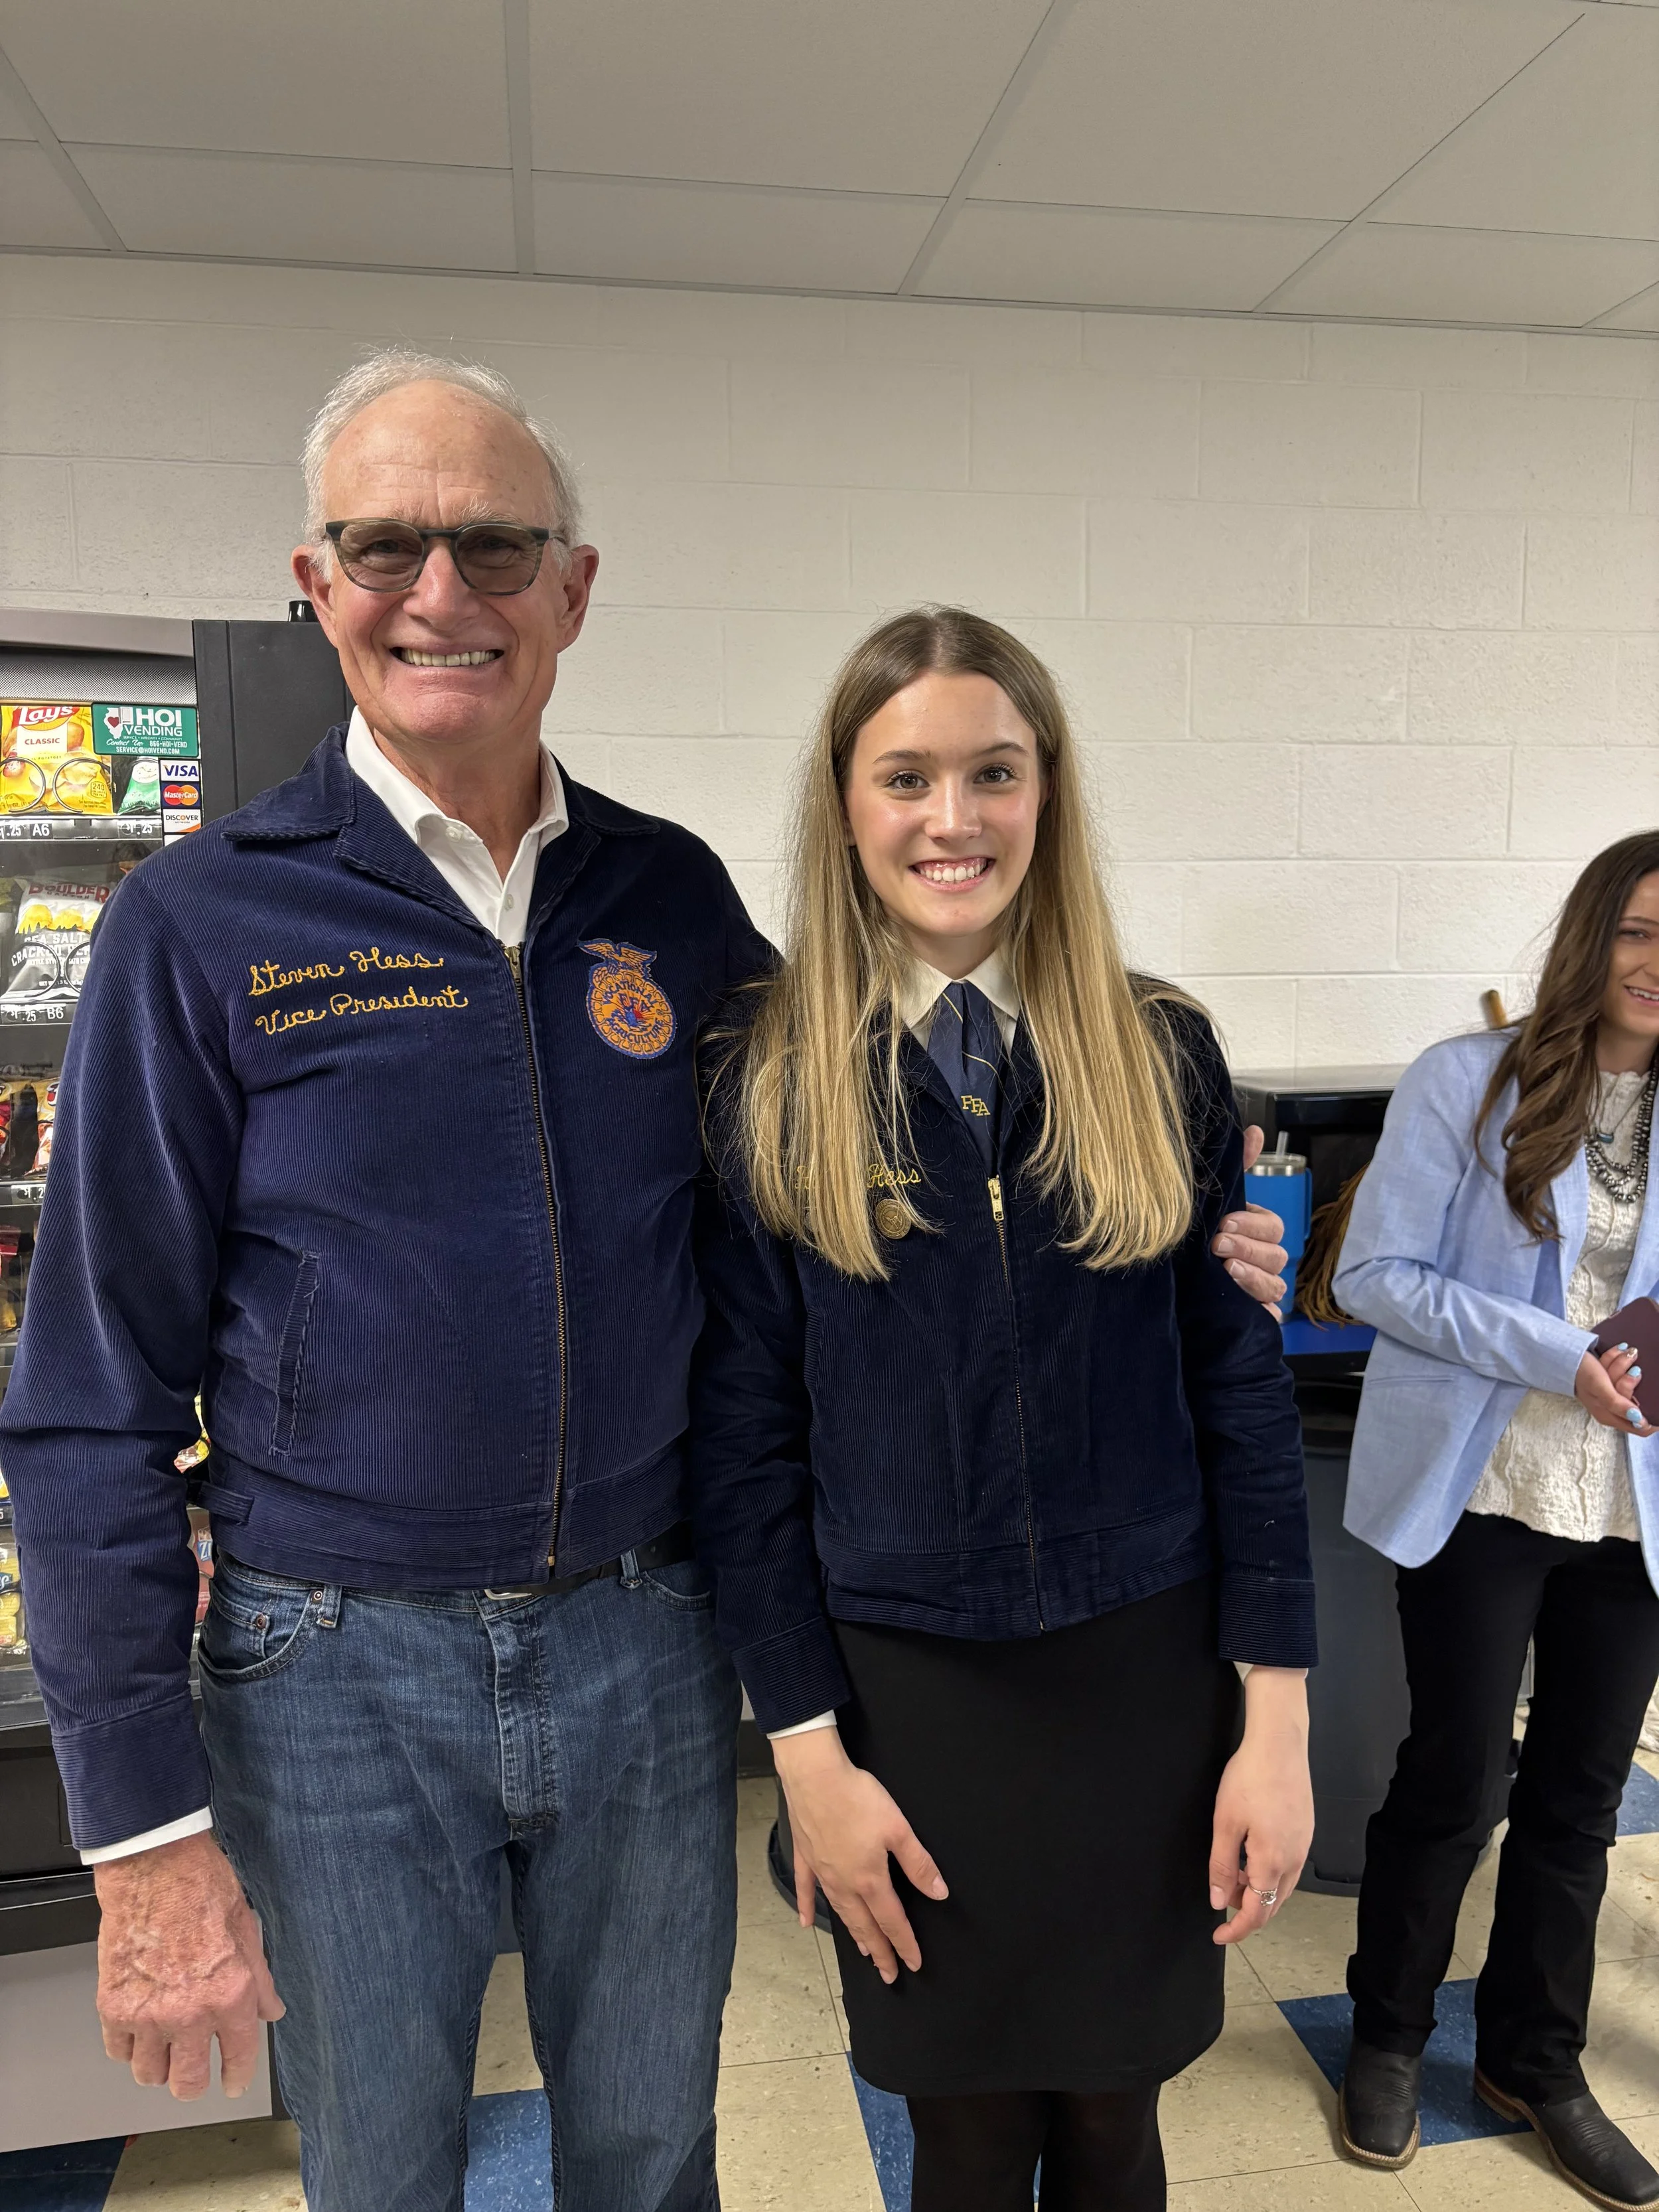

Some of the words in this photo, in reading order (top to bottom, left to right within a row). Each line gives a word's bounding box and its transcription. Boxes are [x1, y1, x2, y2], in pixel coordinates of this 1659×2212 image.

[136, 708, 182, 727] HOI
[123, 725, 182, 737] VENDING
[115, 746, 180, 755] SERVICE@HOIVEND.COM
[163, 764, 198, 776] VISA
[33, 824, 50, 836] A6
[29, 883, 110, 903] BOULDER
[53, 932, 86, 944] SALT
[248, 959, 345, 995] Steven
[349, 947, 445, 972] Hess
[601, 981, 658, 1009] VOCATIONAL
[618, 993, 652, 1012] FFA
[47, 1007, 64, 1019] B6
[255, 1009, 326, 1035] Vice
[330, 986, 469, 1015] President
[605, 1016, 664, 1044] AGRICULTURE
[961, 1095, 991, 1116] FFA
[867, 1163, 922, 1188] Hess
